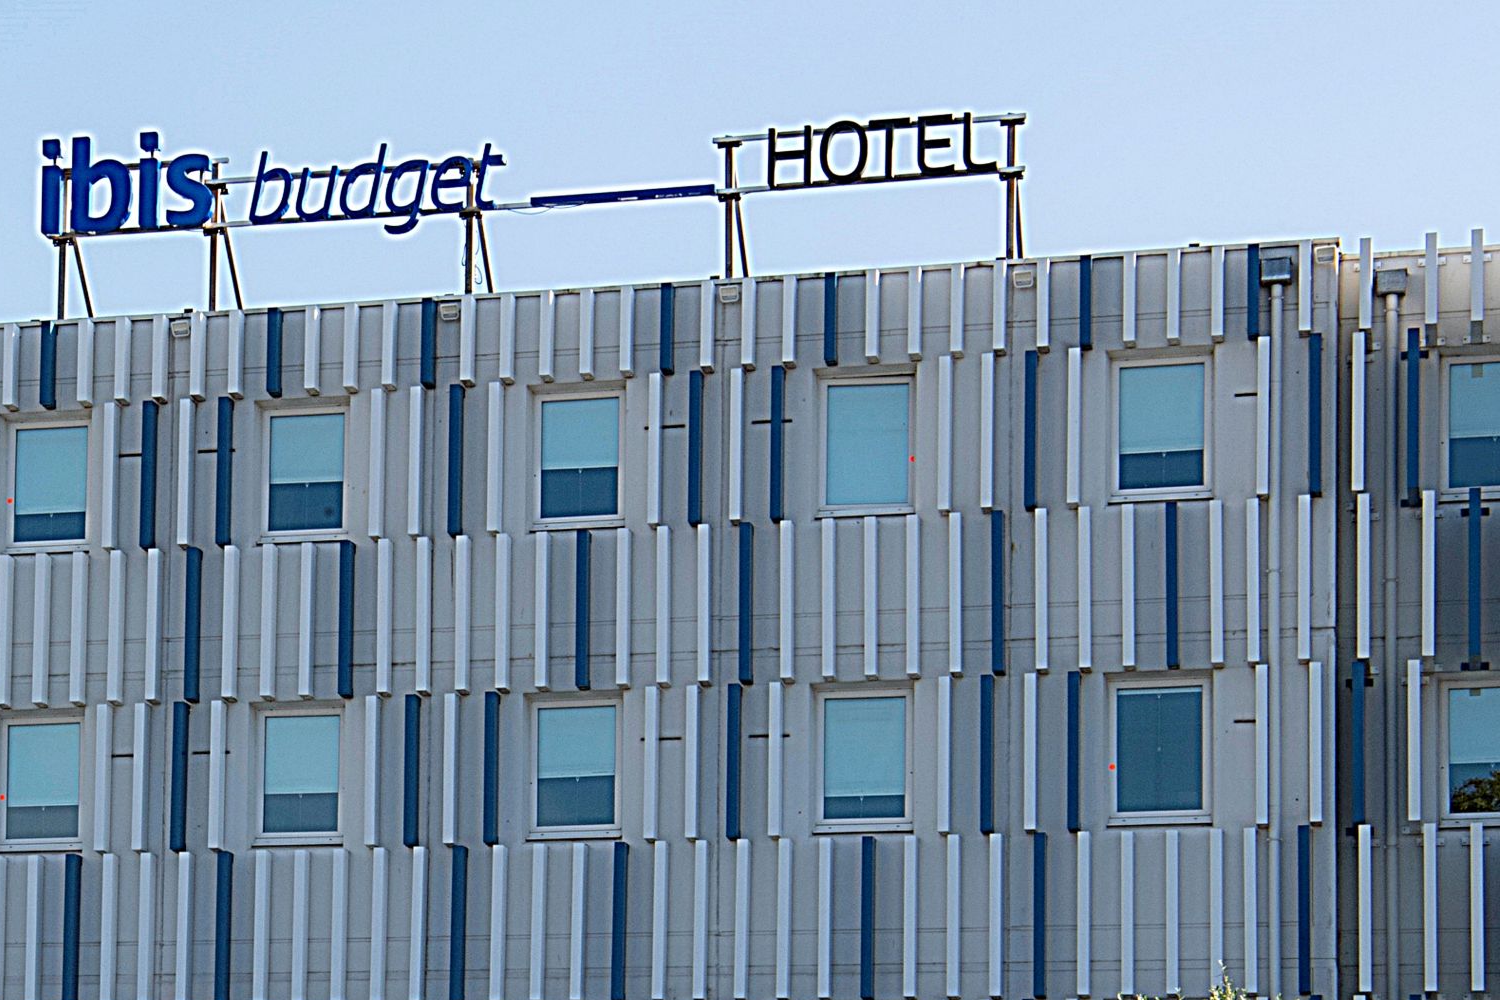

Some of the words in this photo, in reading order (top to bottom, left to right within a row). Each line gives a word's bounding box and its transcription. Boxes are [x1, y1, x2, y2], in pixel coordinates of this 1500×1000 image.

[40, 131, 215, 236] ibis
[249, 142, 506, 235] budget
[767, 112, 998, 189] HOTEL
